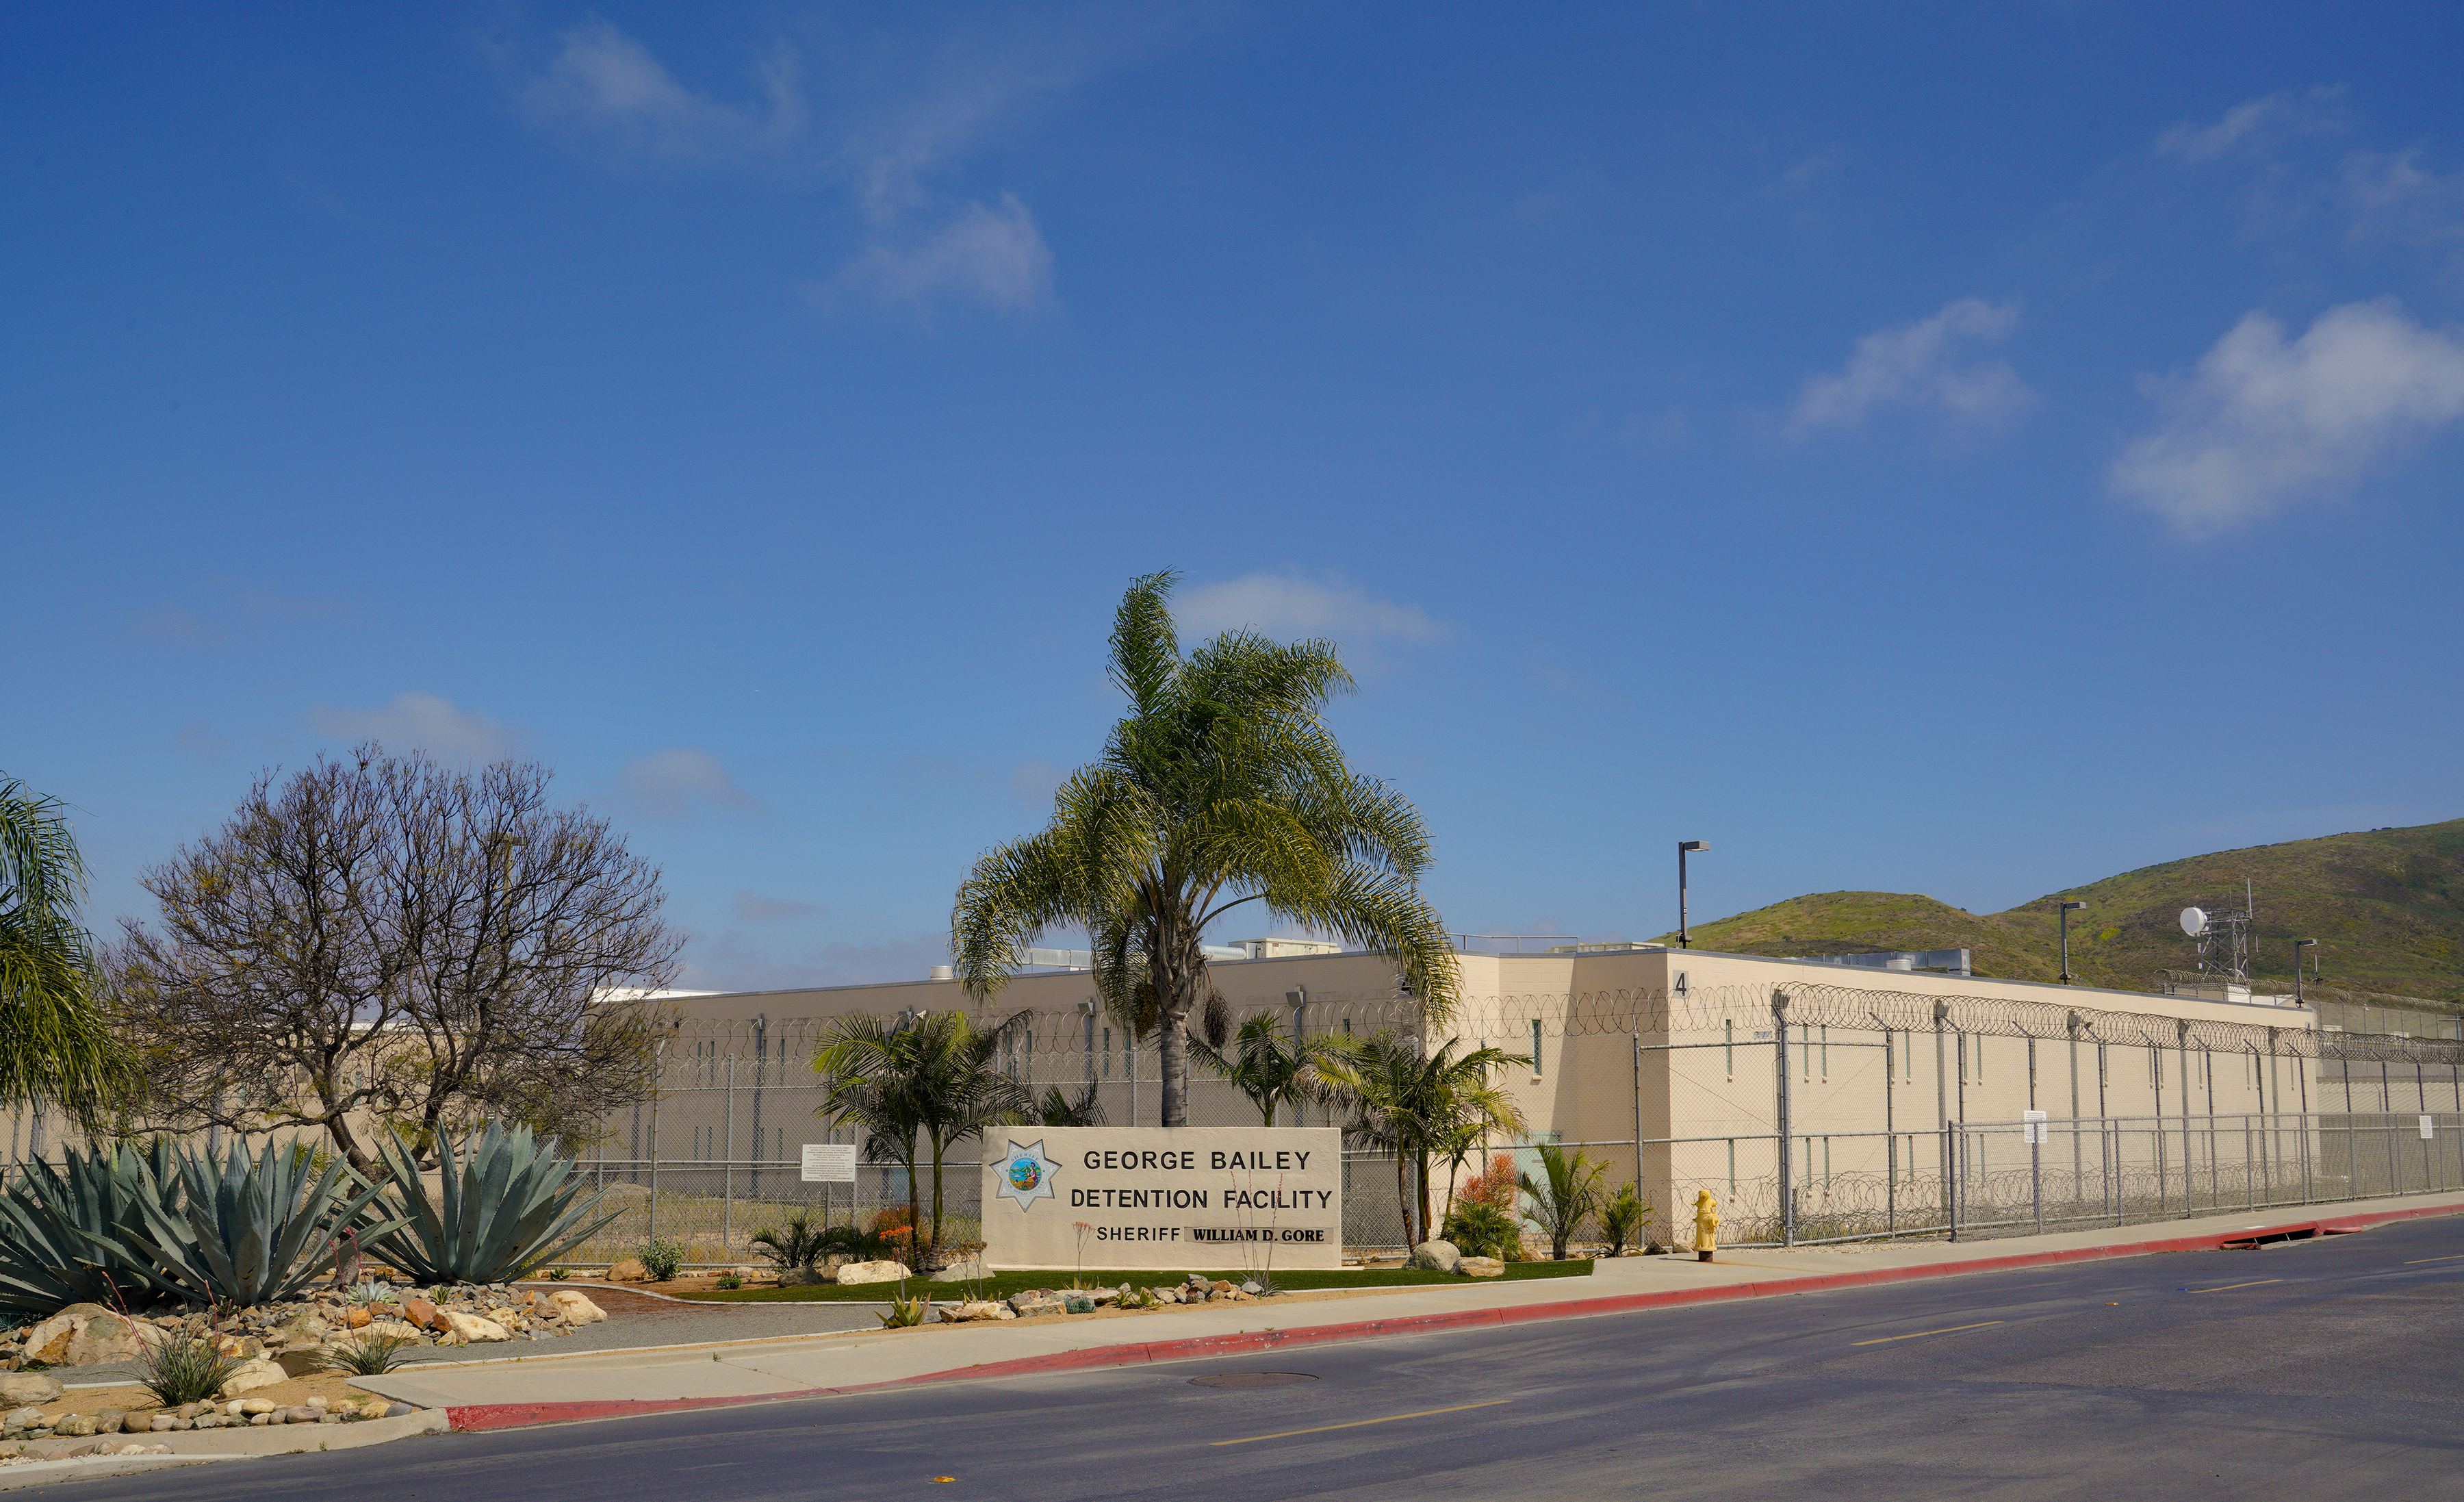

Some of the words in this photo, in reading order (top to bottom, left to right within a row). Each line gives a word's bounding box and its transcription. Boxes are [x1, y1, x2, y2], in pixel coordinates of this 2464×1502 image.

[1676, 973, 1686, 996] 4
[1011, 1153, 1039, 1162] SHERIFF
[1083, 1151, 1194, 1170] GEORGE
[1211, 1151, 1311, 1170] BAILEY
[1029, 1182, 1044, 1195] COUNTY
[1071, 1188, 1207, 1209] DETENTION
[1224, 1190, 1333, 1209] FACILITY
[1096, 1227, 1181, 1241] SHERIFF
[1192, 1230, 1258, 1242] WILLIAM
[1262, 1230, 1278, 1242] D.
[1281, 1230, 1324, 1242] GORE
